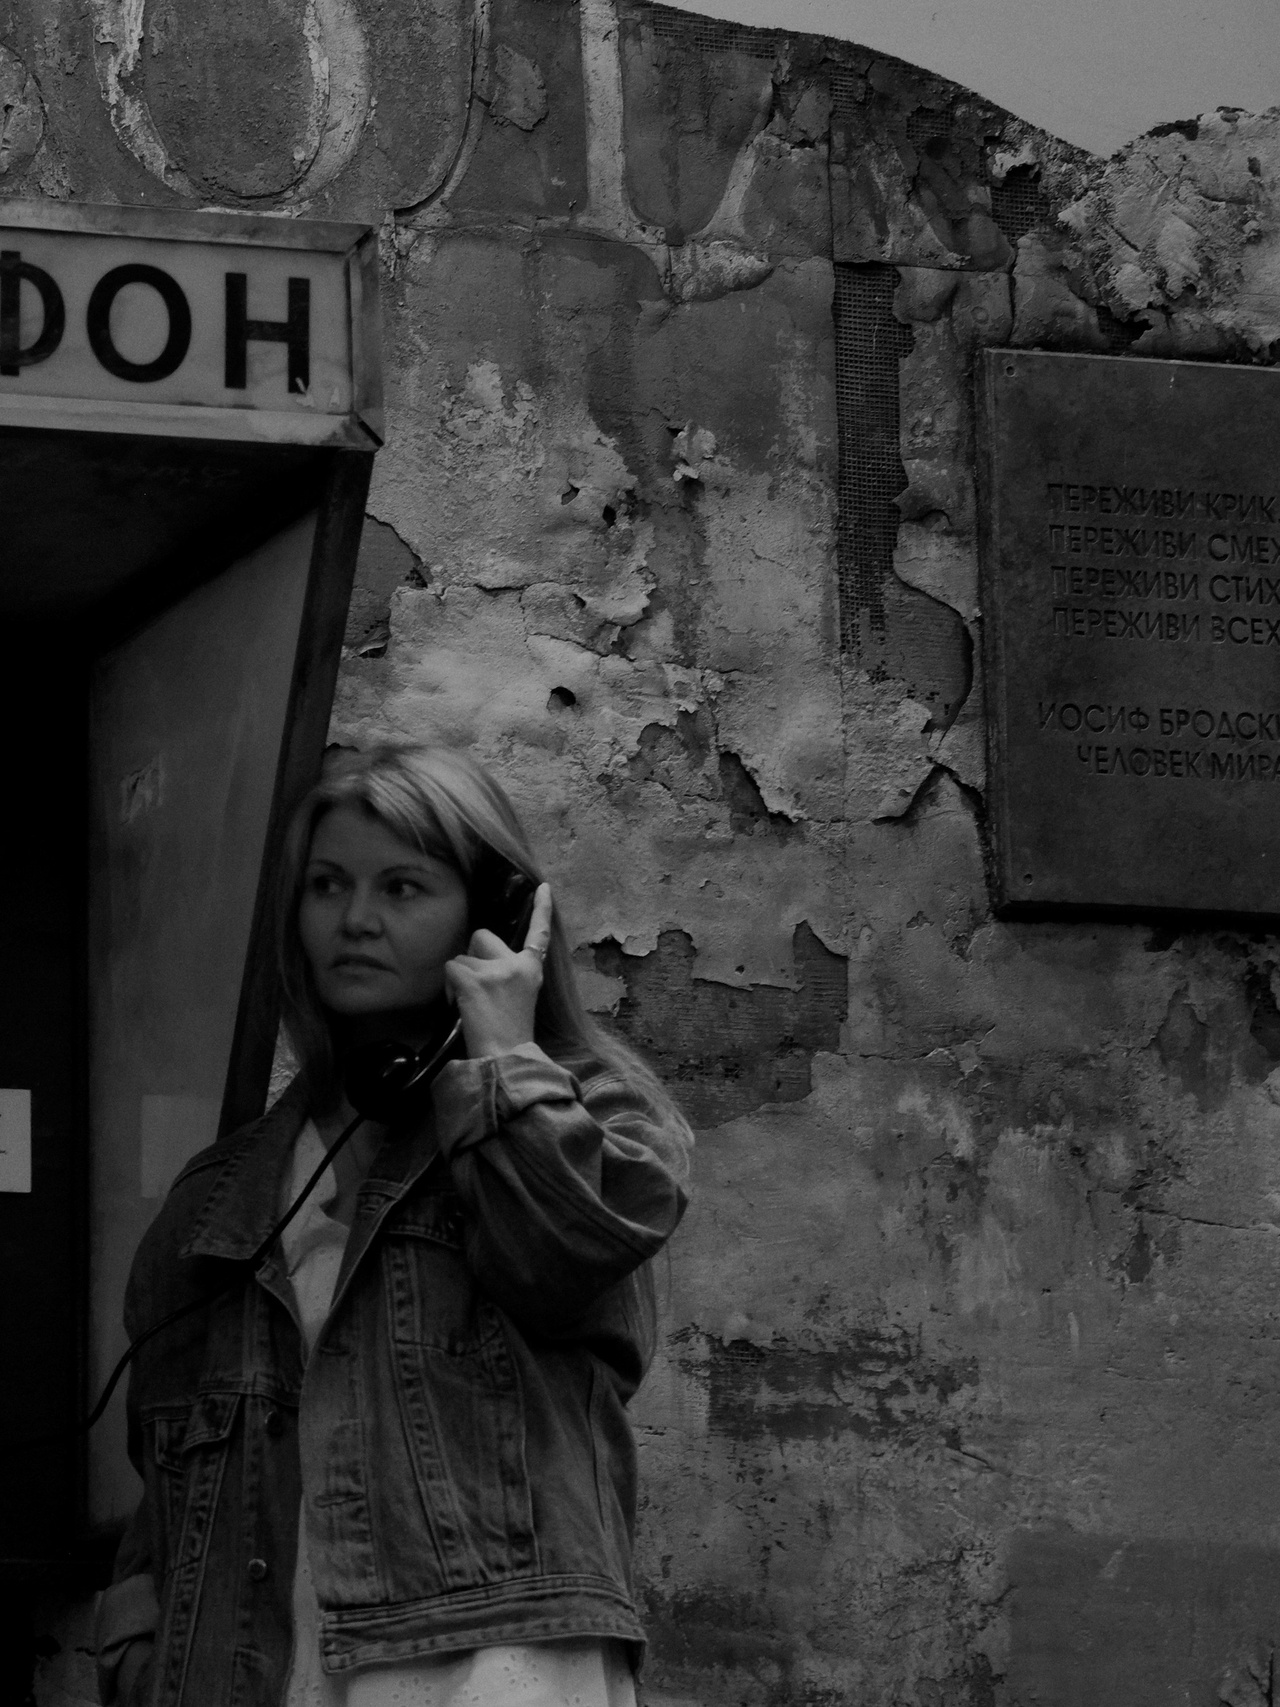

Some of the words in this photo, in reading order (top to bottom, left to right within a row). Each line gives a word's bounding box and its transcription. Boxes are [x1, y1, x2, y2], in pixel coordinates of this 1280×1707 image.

[1047, 483, 1195, 519] ПЕРЕЖИВИ
[1049, 524, 1197, 560] ПЕРЕЖИВИ
[1051, 565, 1199, 601] ПЕРЕЖИВИ
[1052, 607, 1200, 642] ПЕРЕЖИВИ
[1038, 702, 1149, 735] ИОСИФ
[1077, 745, 1202, 778] ЧЕЛОВЕК
